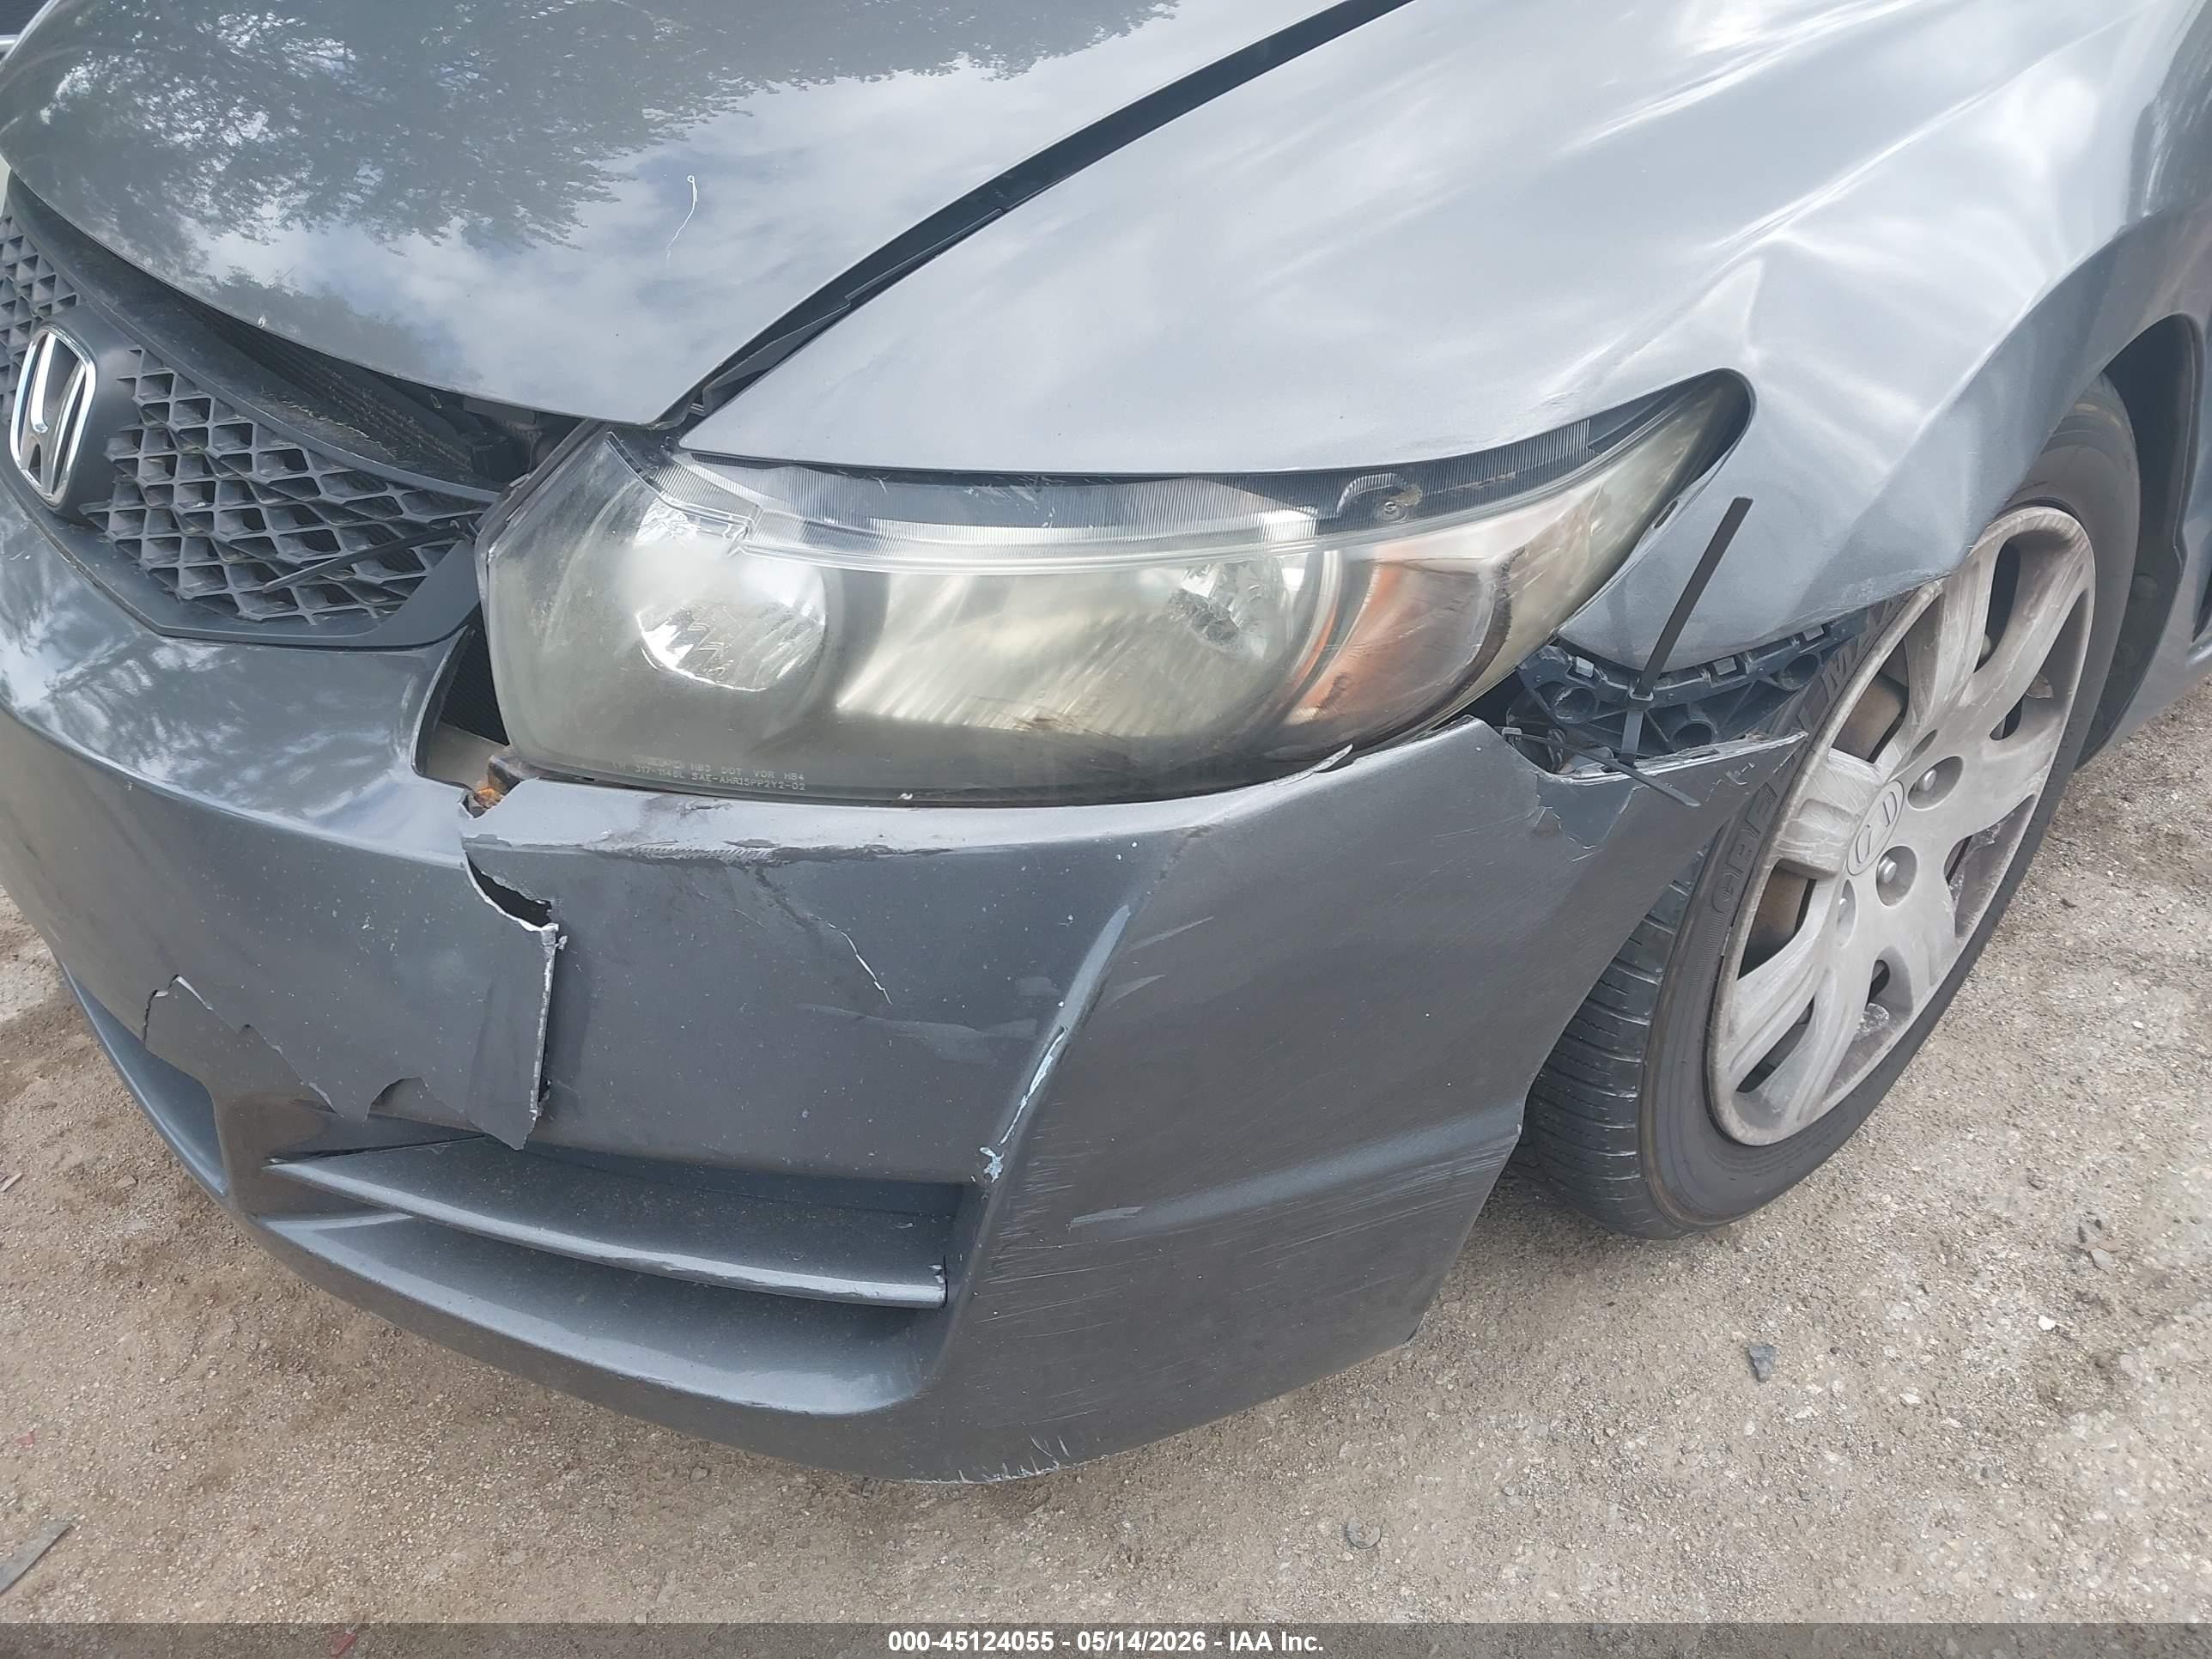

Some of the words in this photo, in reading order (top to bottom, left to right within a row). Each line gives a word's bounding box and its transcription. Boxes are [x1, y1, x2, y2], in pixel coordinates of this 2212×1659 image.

[721, 765, 743, 776] DOT
[753, 769, 775, 779] VOR
[783, 771, 805, 781] HB4
